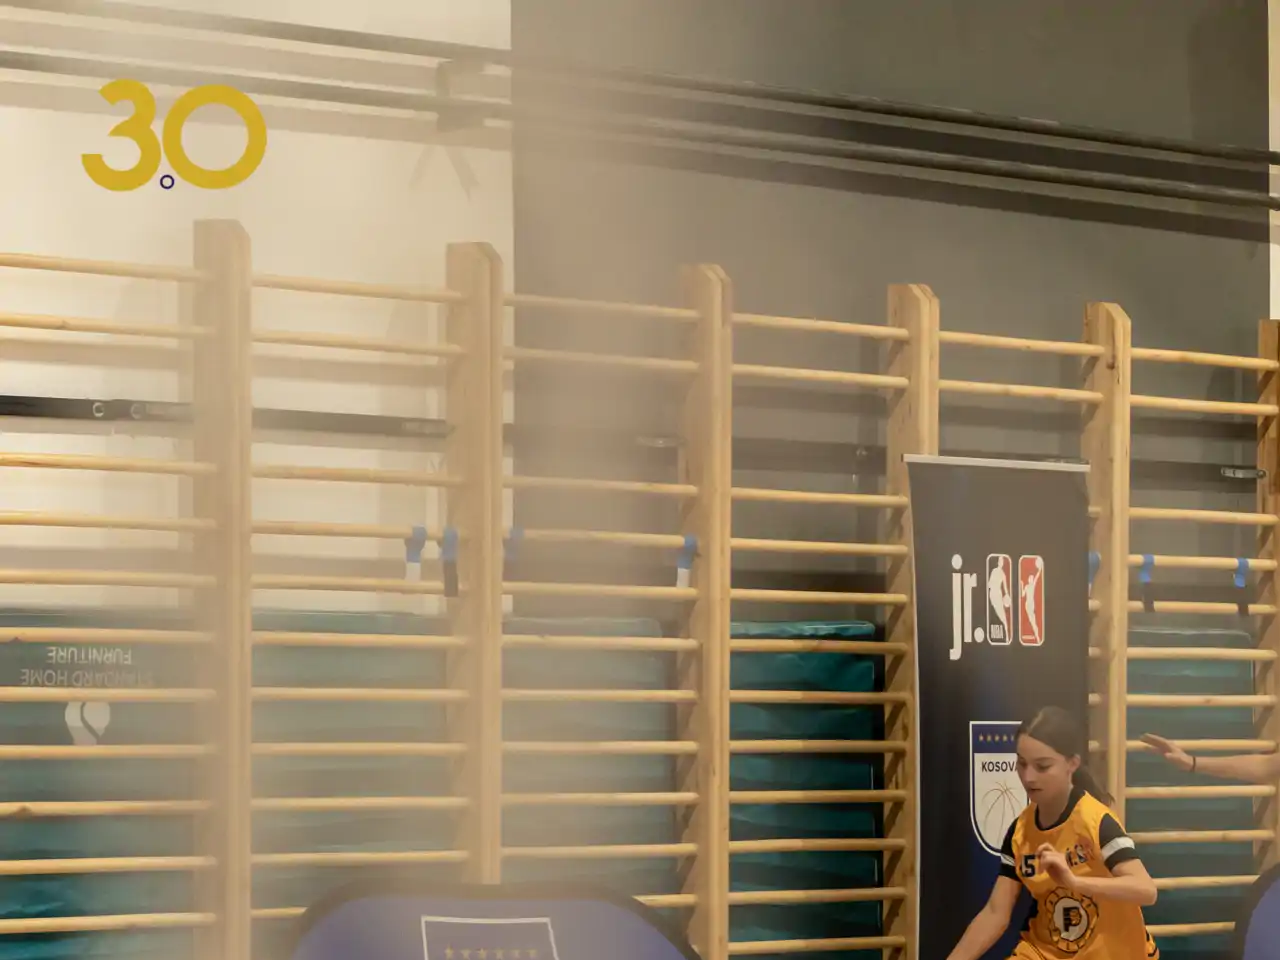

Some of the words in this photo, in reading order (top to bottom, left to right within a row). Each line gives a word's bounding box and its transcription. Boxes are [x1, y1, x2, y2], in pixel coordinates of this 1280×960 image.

[949, 553, 986, 661] jr.
[45, 647, 133, 665] FURNITURE
[19, 668, 69, 686] HOME
[981, 761, 1018, 773] KOSOV
